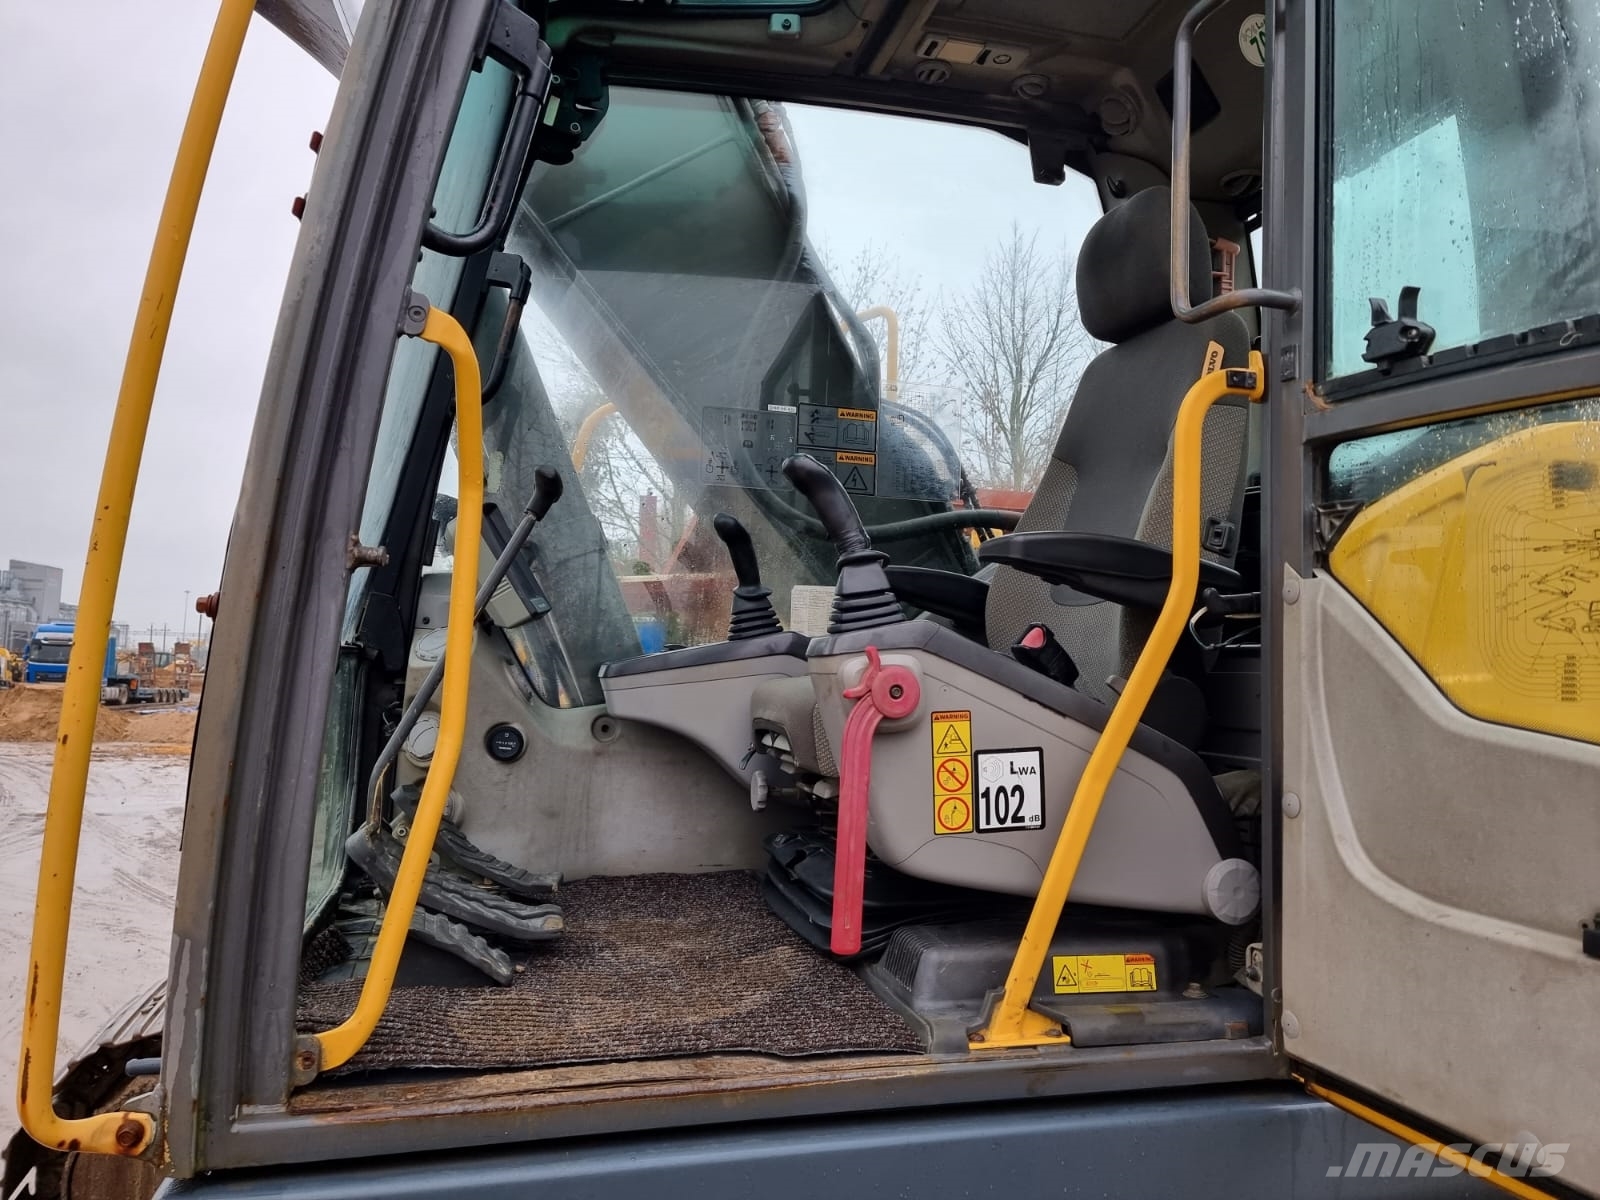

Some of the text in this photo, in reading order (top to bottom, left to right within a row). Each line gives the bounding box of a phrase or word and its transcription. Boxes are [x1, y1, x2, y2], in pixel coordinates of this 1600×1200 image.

[846, 411, 875, 420] WARNING
[844, 455, 873, 463] WARNING
[980, 784, 1026, 826] 102
[1028, 814, 1041, 823] dB
